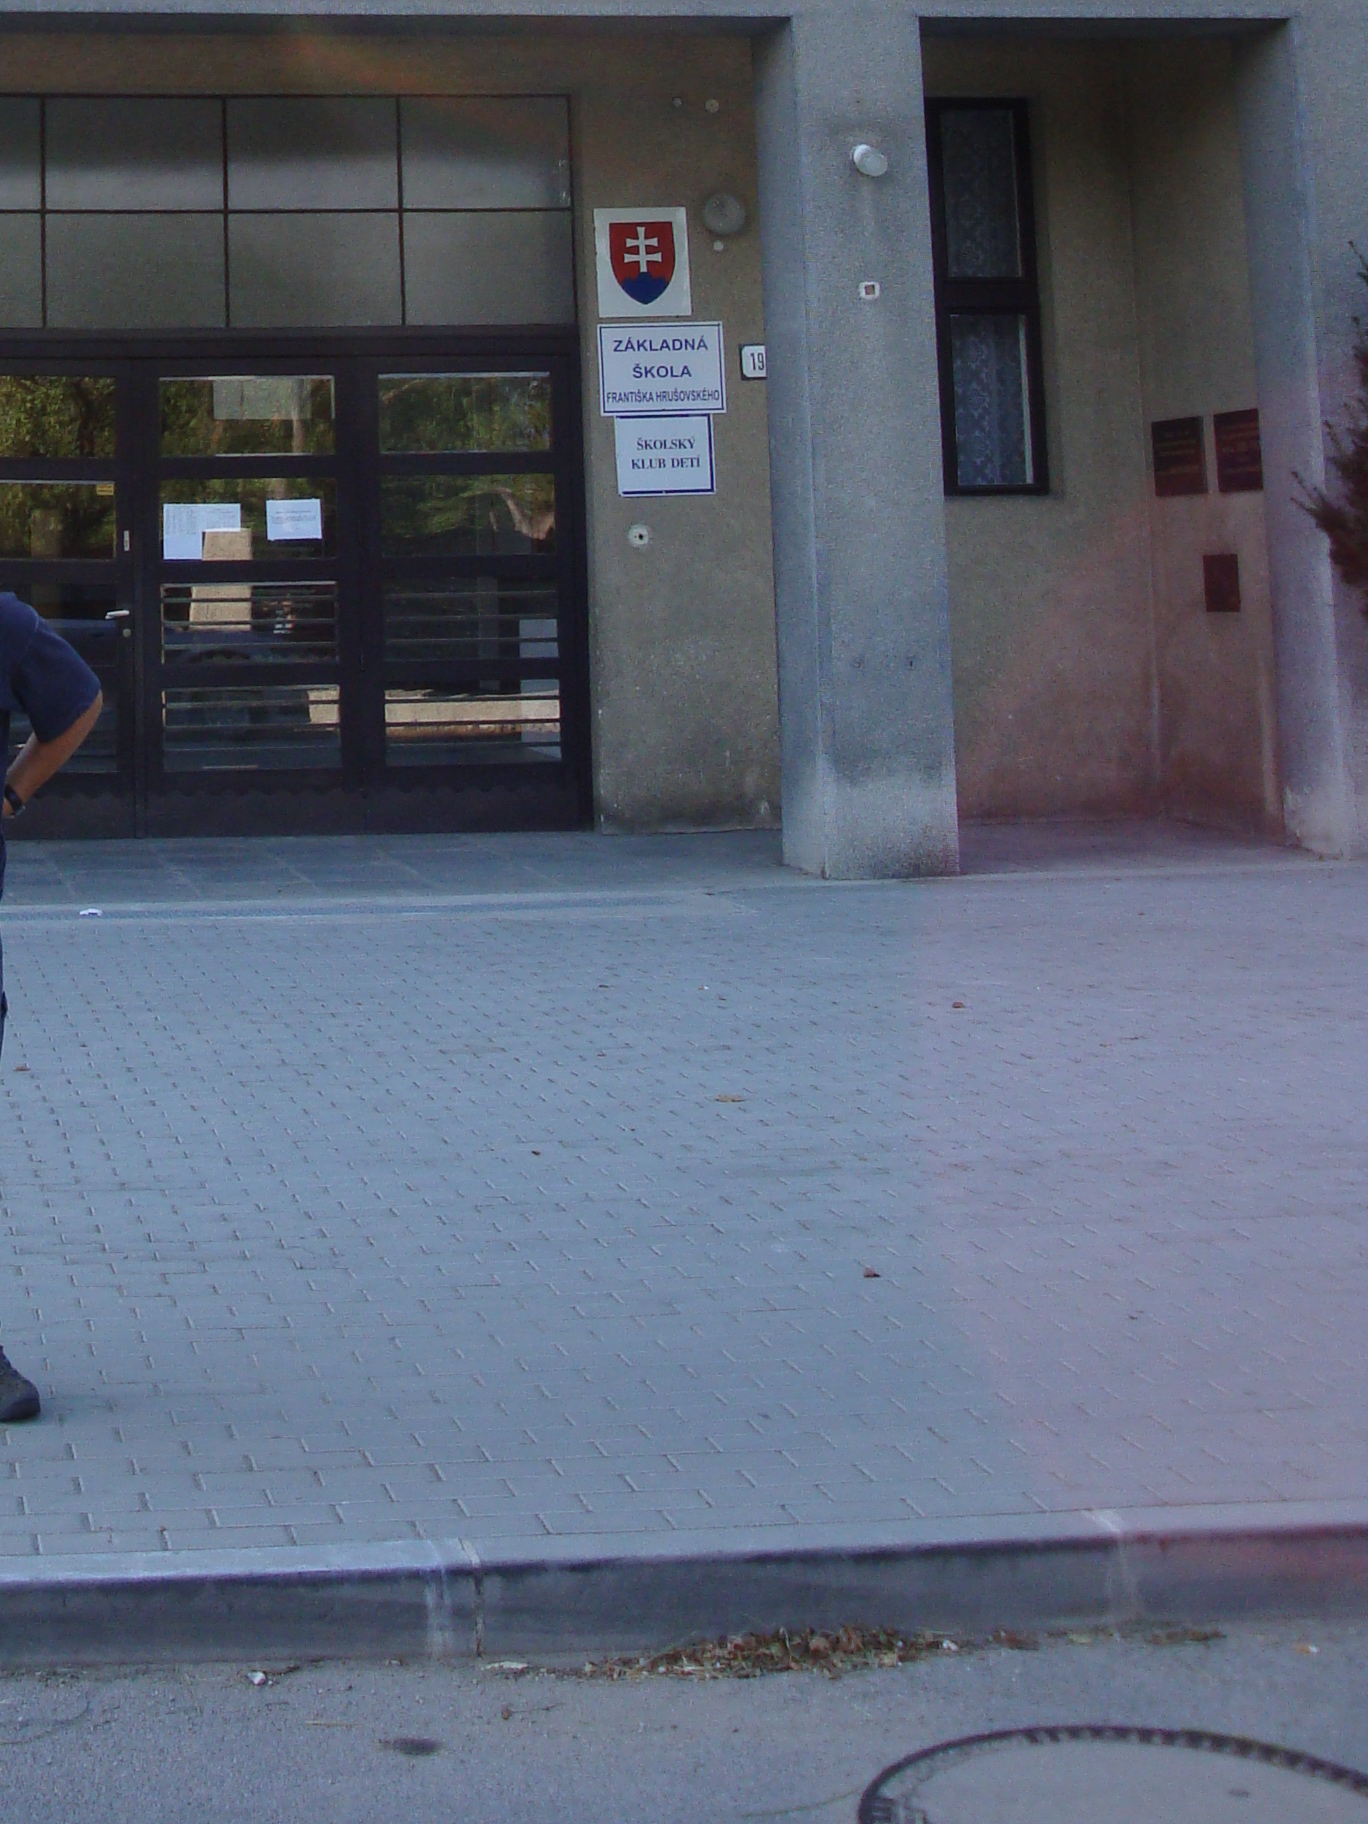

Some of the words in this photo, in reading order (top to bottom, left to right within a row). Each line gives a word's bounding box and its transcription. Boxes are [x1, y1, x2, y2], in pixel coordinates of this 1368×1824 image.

[613, 334, 708, 352] ZÁKLADNÁ
[750, 352, 765, 371] 19
[632, 363, 692, 379] ŠKOLA
[606, 388, 654, 403] FRANTIŠKA
[655, 387, 720, 402] HRUŠOVSKÉHO
[636, 437, 696, 451] ŠKOLSKÝ
[631, 457, 666, 470] KLUB
[671, 454, 701, 469] DETÍ
